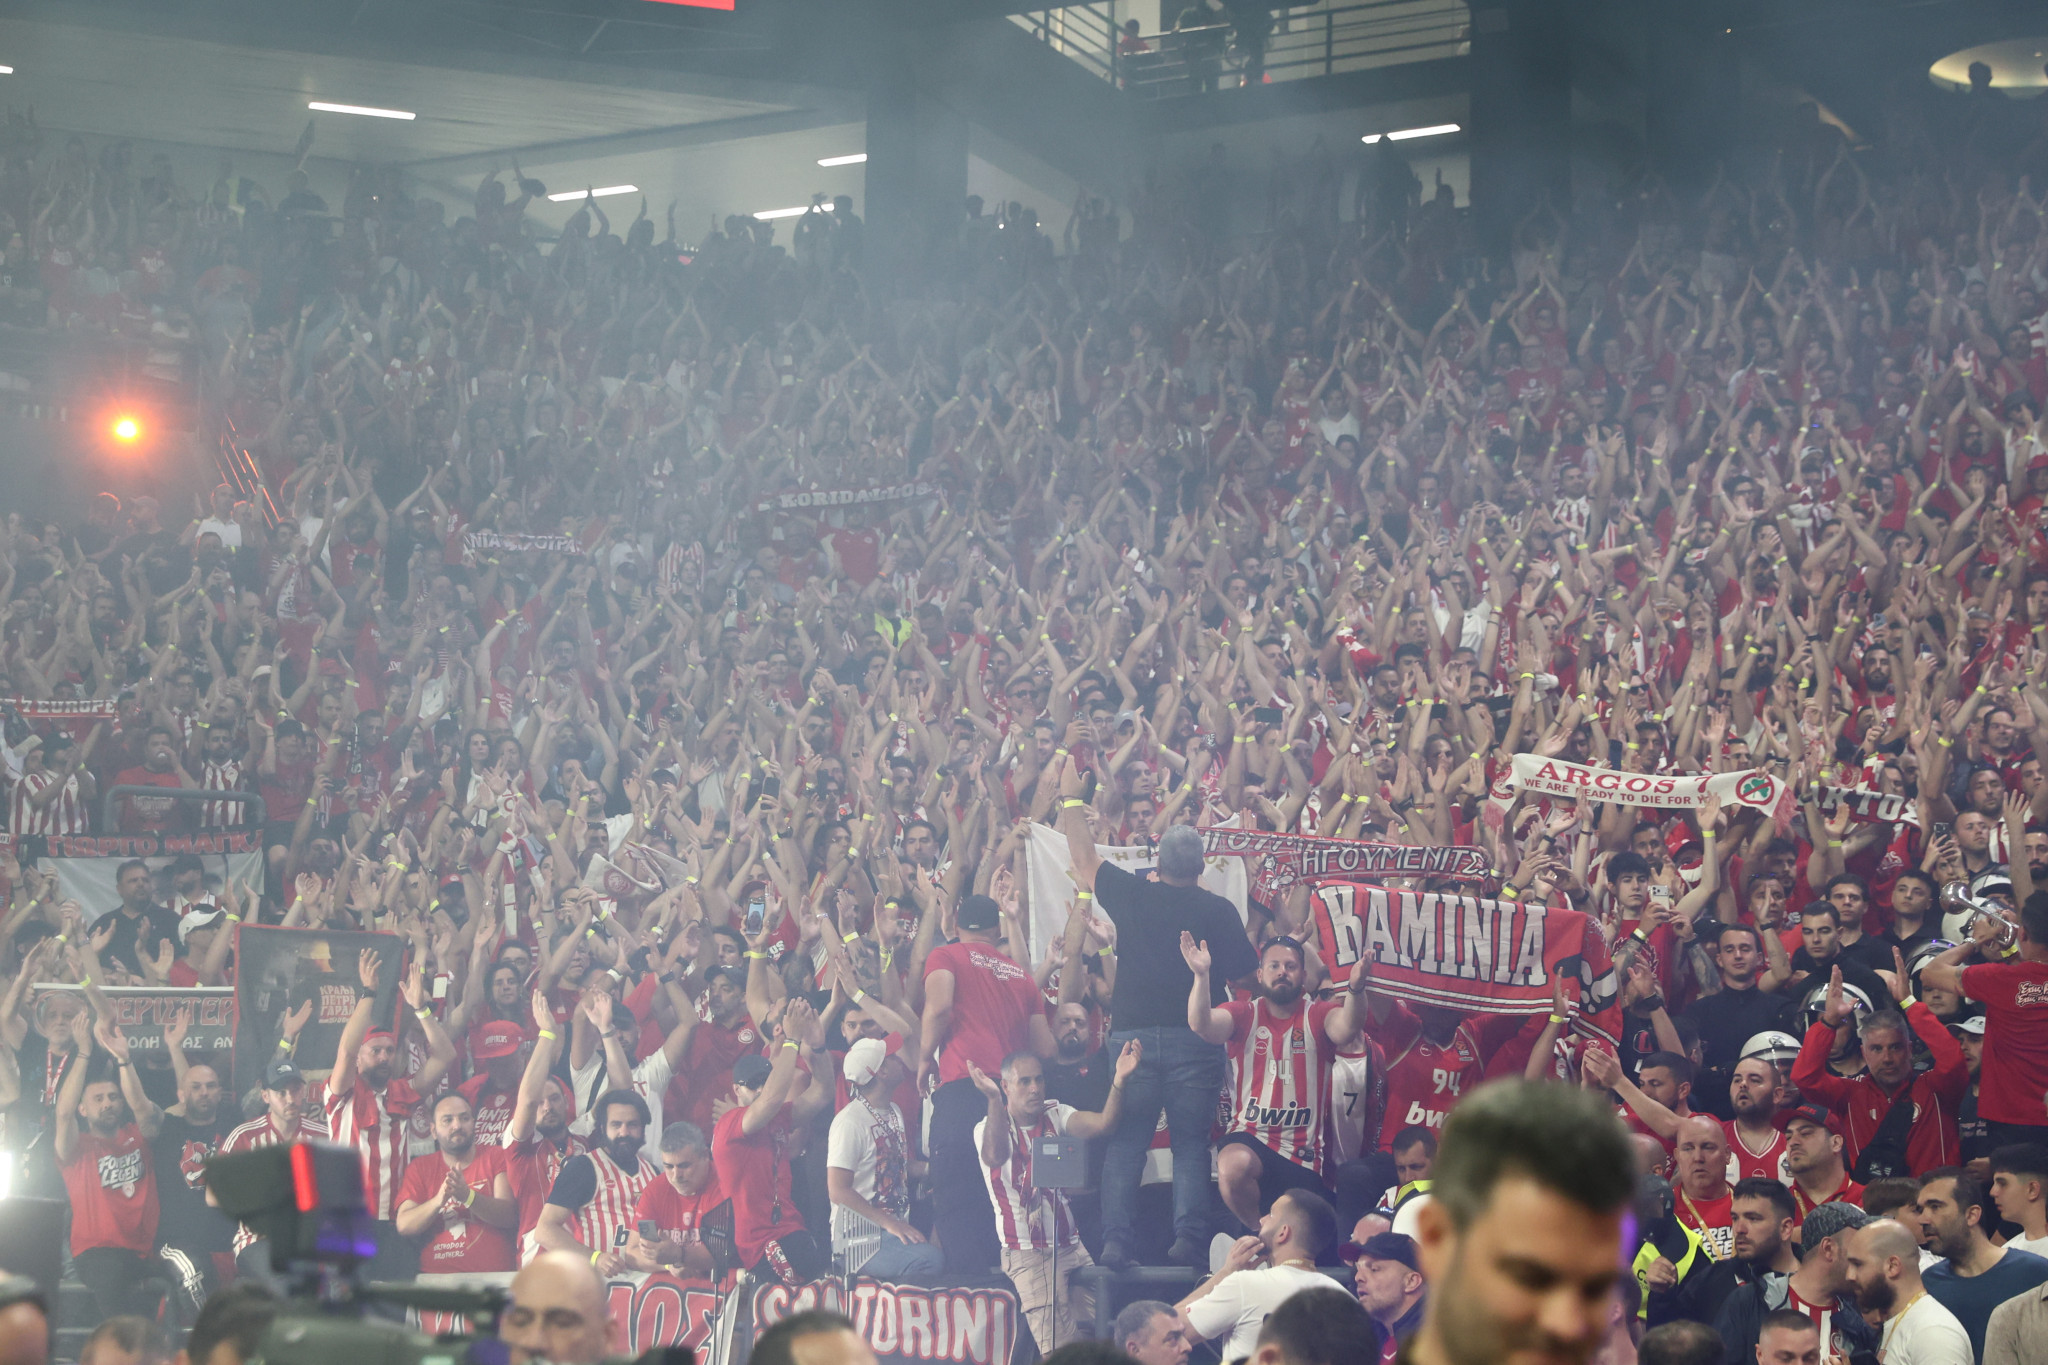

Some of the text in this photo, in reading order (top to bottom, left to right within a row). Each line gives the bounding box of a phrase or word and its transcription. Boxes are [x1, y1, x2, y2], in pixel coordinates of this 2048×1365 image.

[780, 482, 932, 508] KORIDALLOS
[37, 699, 116, 714] EUROPE
[1524, 778, 1541, 788] WE
[1546, 782, 1569, 793] ARE
[1576, 786, 1614, 800] EADY
[1620, 793, 1635, 803] TO
[1641, 795, 1662, 805] DIE
[1667, 796, 1692, 805] FOR
[1536, 762, 1714, 794] ARGOS 7
[1318, 884, 1549, 987] KAMINIA
[109, 996, 234, 1026] ΕΡΙΣΤΕΡ
[127, 1036, 160, 1049] ΟΛΗ
[181, 1036, 204, 1049] ΑΣ
[1268, 1058, 1294, 1086] 94
[1432, 1068, 1461, 1096] 94
[1244, 1096, 1312, 1127] bwin
[1343, 1091, 1359, 1117] 7
[1405, 1100, 1450, 1128] bw
[433, 1241, 466, 1252] ORTHODOX
[434, 1250, 465, 1260] BROTHERS
